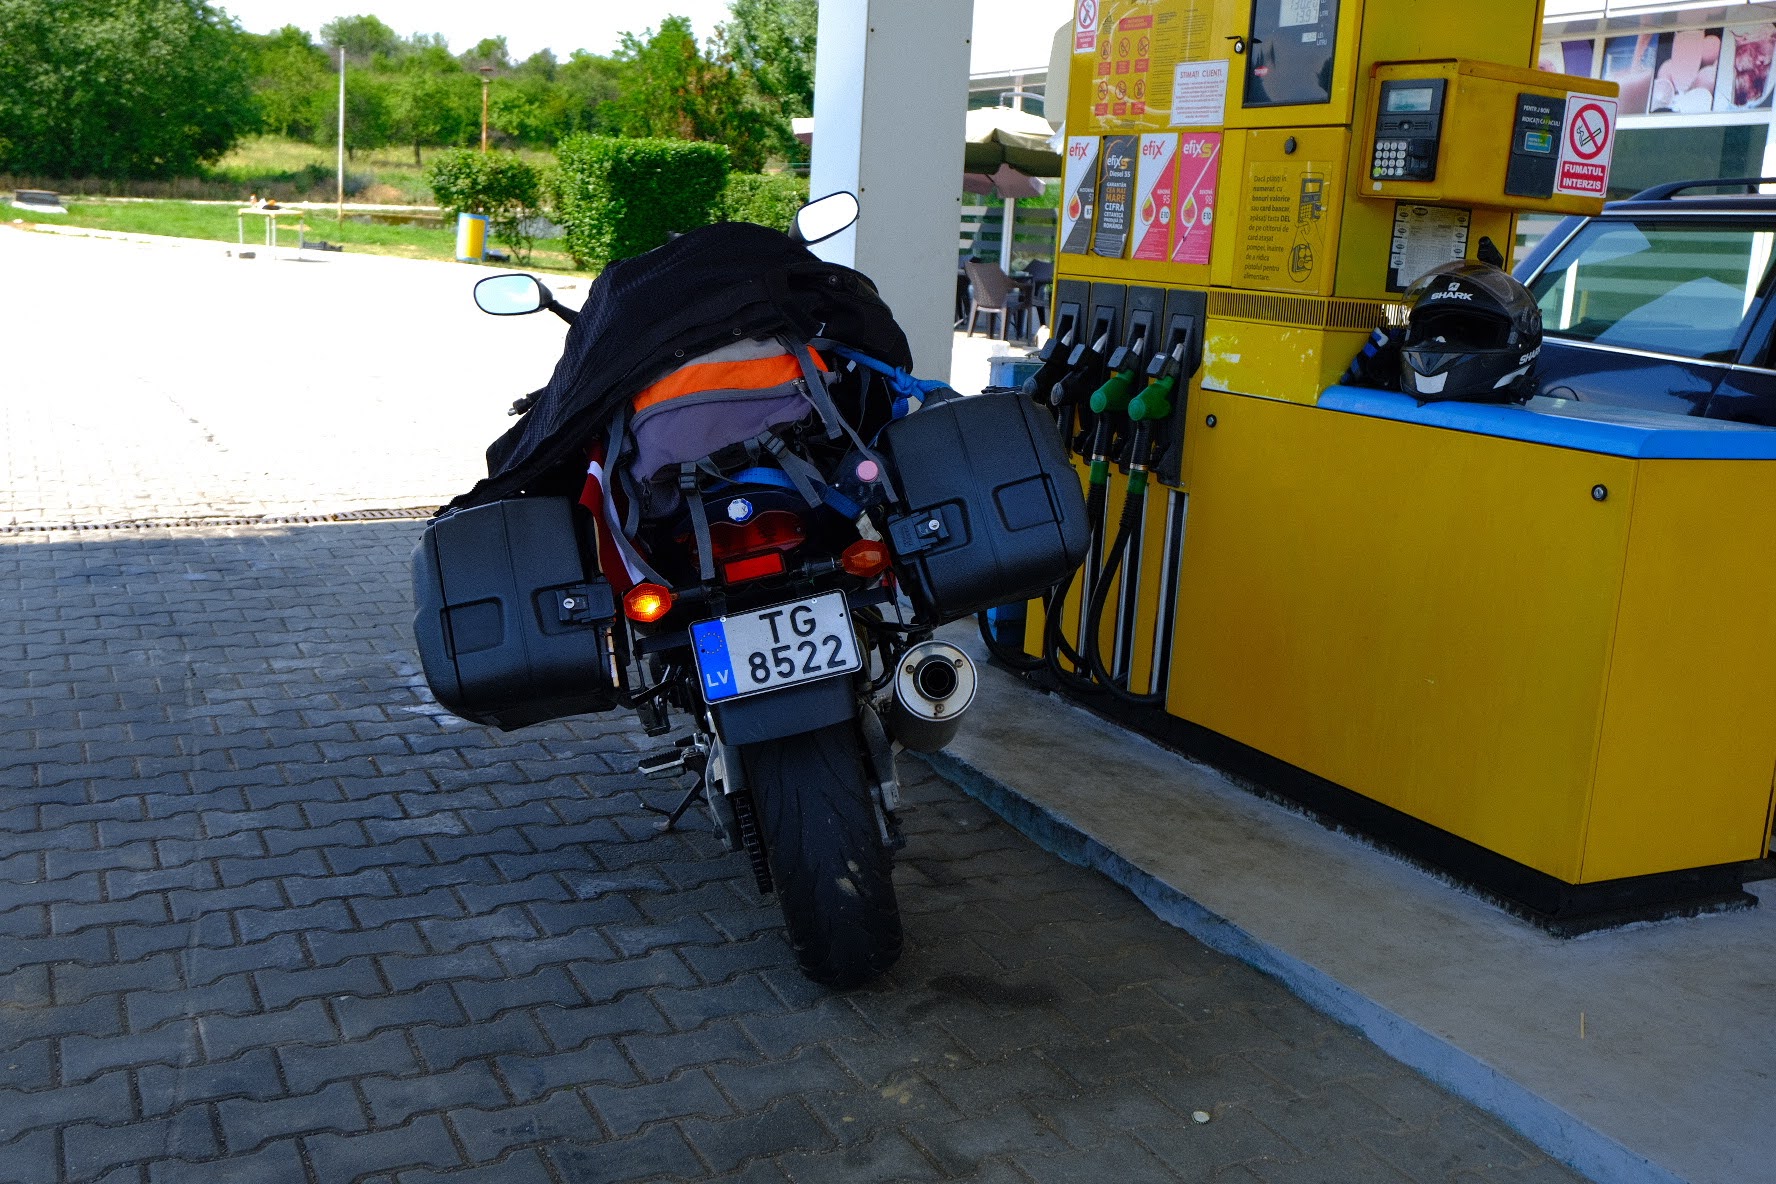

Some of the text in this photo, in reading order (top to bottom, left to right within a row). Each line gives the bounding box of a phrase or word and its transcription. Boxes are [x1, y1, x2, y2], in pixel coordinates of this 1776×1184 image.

[1069, 142, 1090, 160] efix
[1142, 140, 1166, 159] efix
[1109, 170, 1123, 178] Diesel
[1564, 163, 1603, 176] FUMATUL
[1562, 178, 1601, 190] INTERZIS
[1105, 193, 1126, 202] MARE
[1163, 195, 1170, 204] 95
[1205, 195, 1213, 204] 98
[1259, 204, 1271, 212] card
[1160, 211, 1170, 219] E10
[1203, 212, 1212, 220] E10
[1430, 292, 1474, 301] SHARK
[758, 605, 817, 644] TG
[748, 634, 847, 684] 8522
[706, 669, 729, 687] LV
